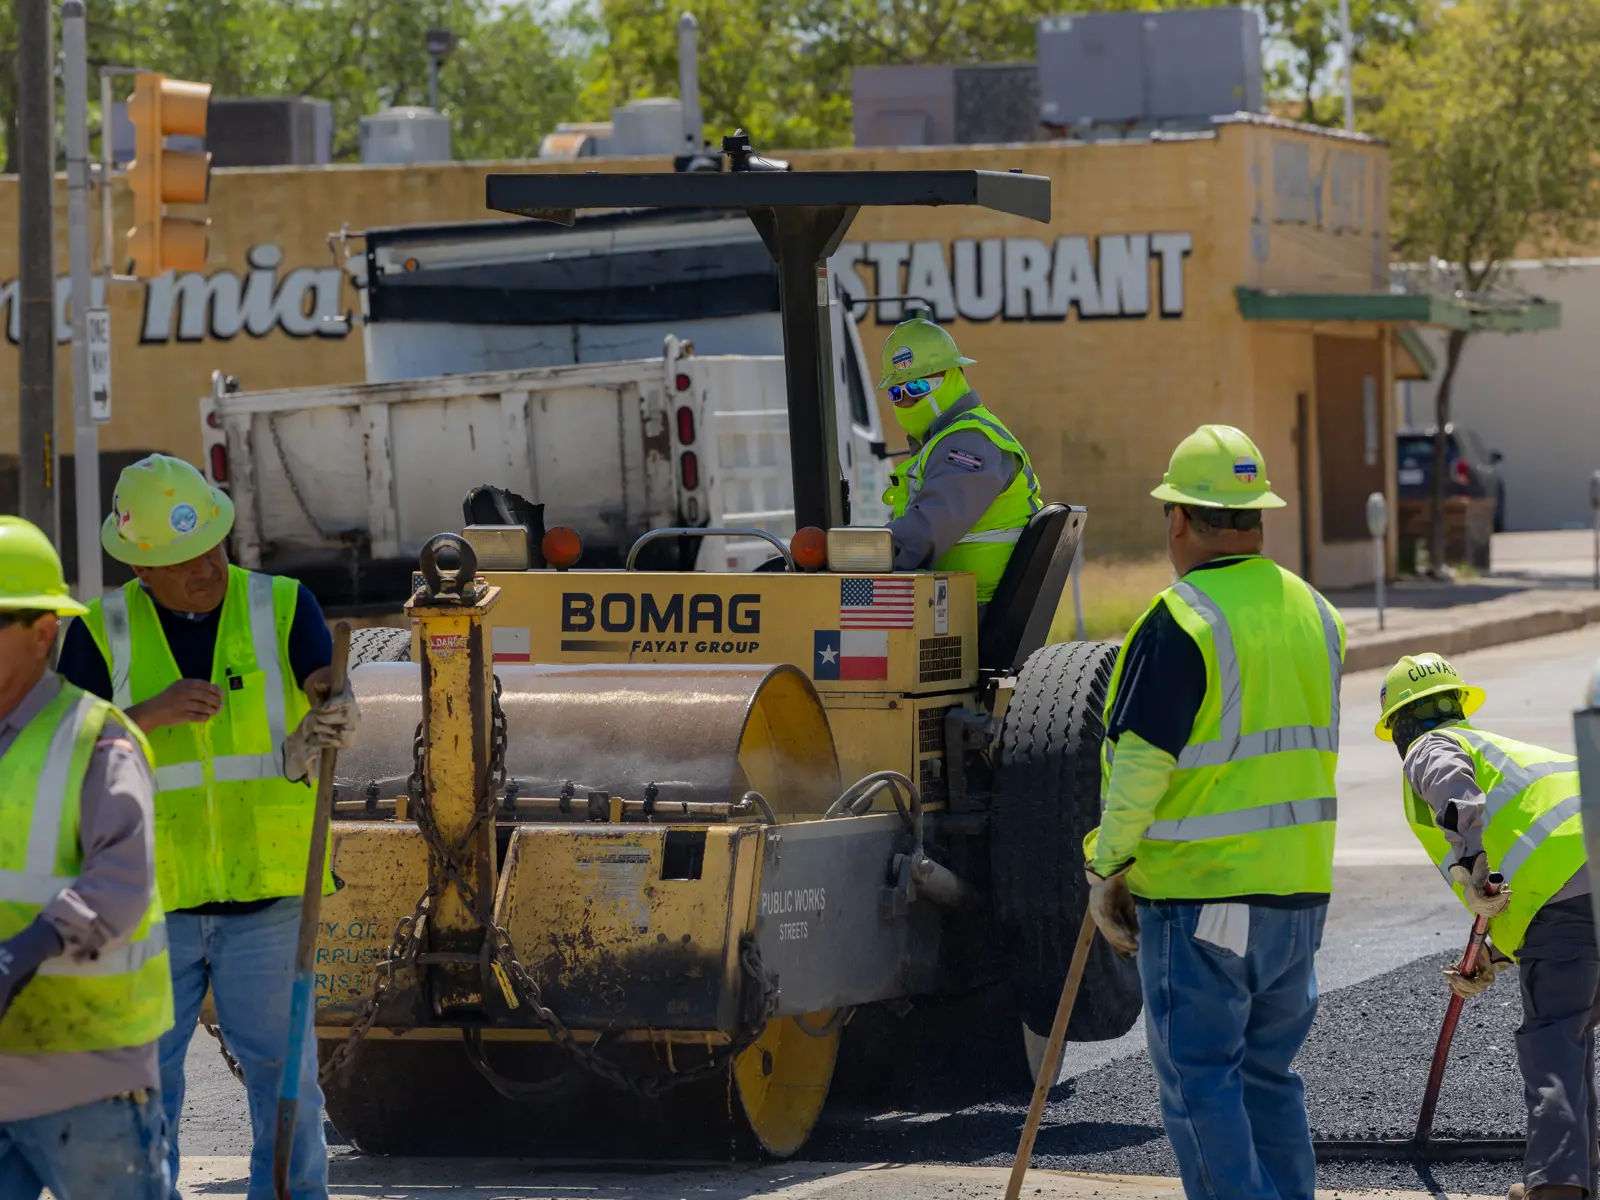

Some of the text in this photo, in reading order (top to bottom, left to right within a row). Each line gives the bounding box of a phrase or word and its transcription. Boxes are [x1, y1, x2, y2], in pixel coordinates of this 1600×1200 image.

[139, 244, 352, 345] mia
[831, 232, 1193, 326] STAURANT
[88, 318, 108, 343] ONE
[561, 592, 761, 634] BOMAG
[631, 641, 760, 654] FAYAT GROUP
[761, 887, 826, 916] PUBLIC WORKS
[779, 921, 808, 941] STREETS
[316, 947, 374, 964] RPUS
[314, 973, 372, 990] RISTI
